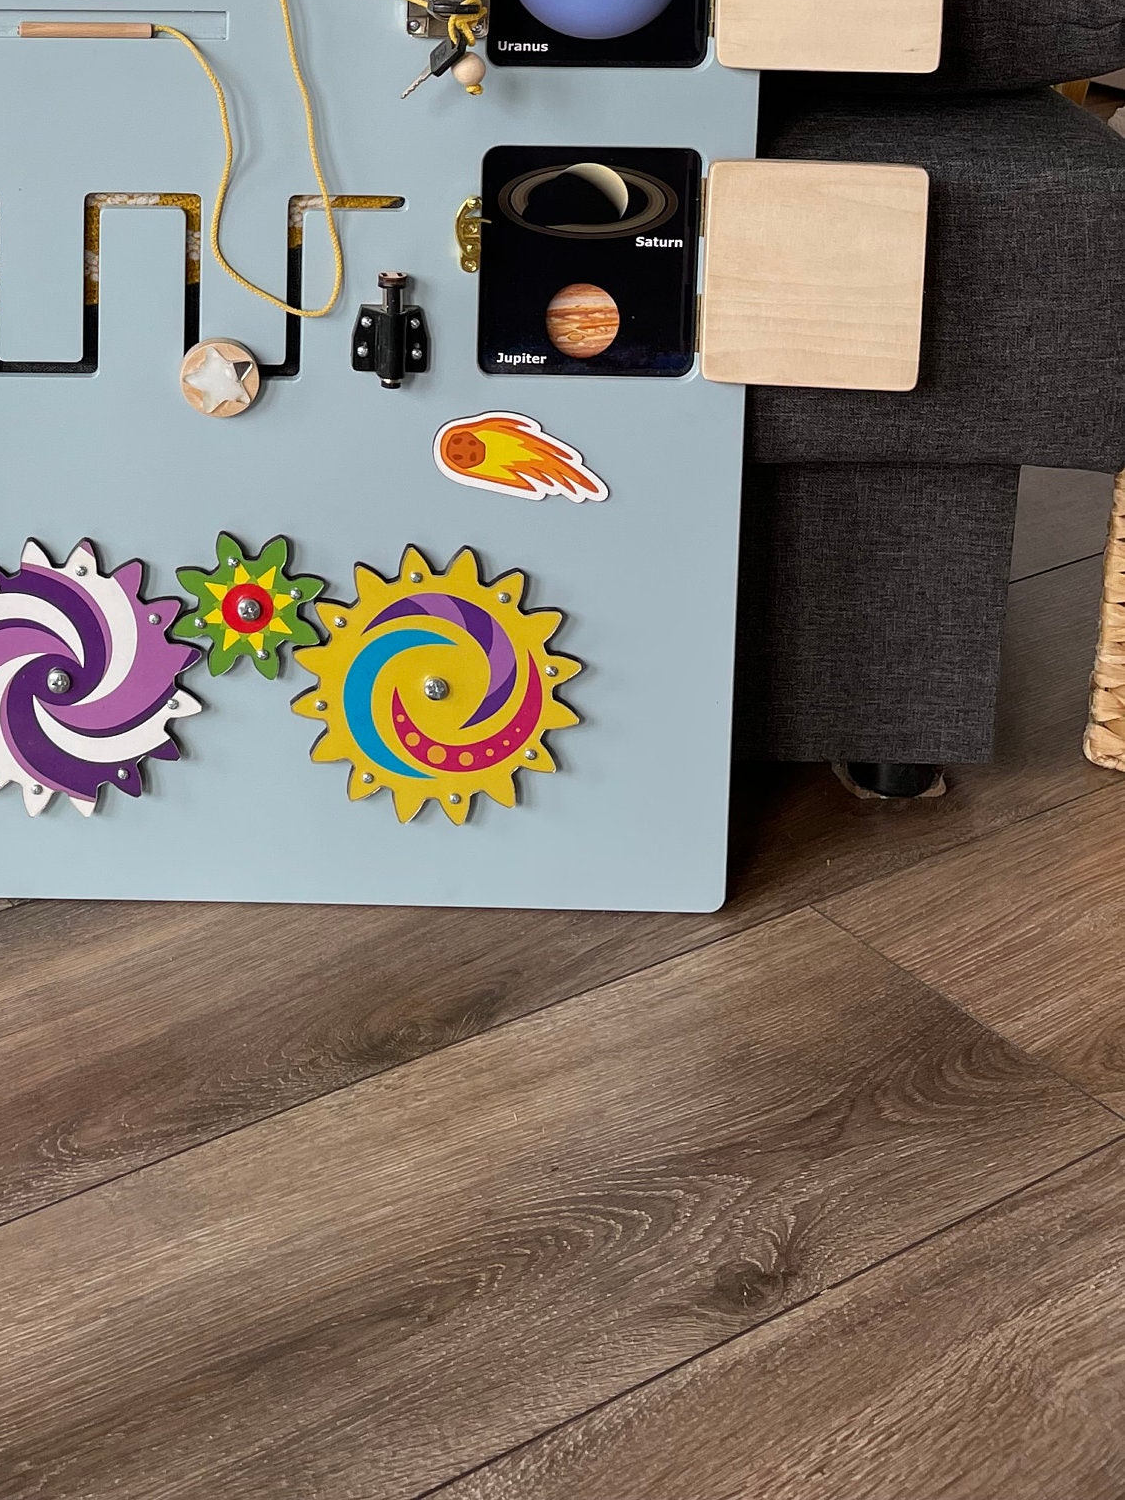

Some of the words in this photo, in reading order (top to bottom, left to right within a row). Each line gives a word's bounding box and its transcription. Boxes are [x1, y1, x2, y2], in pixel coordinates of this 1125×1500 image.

[497, 40, 549, 52] Uranus
[635, 236, 683, 248] Saturn
[496, 352, 547, 366] Jupiter
